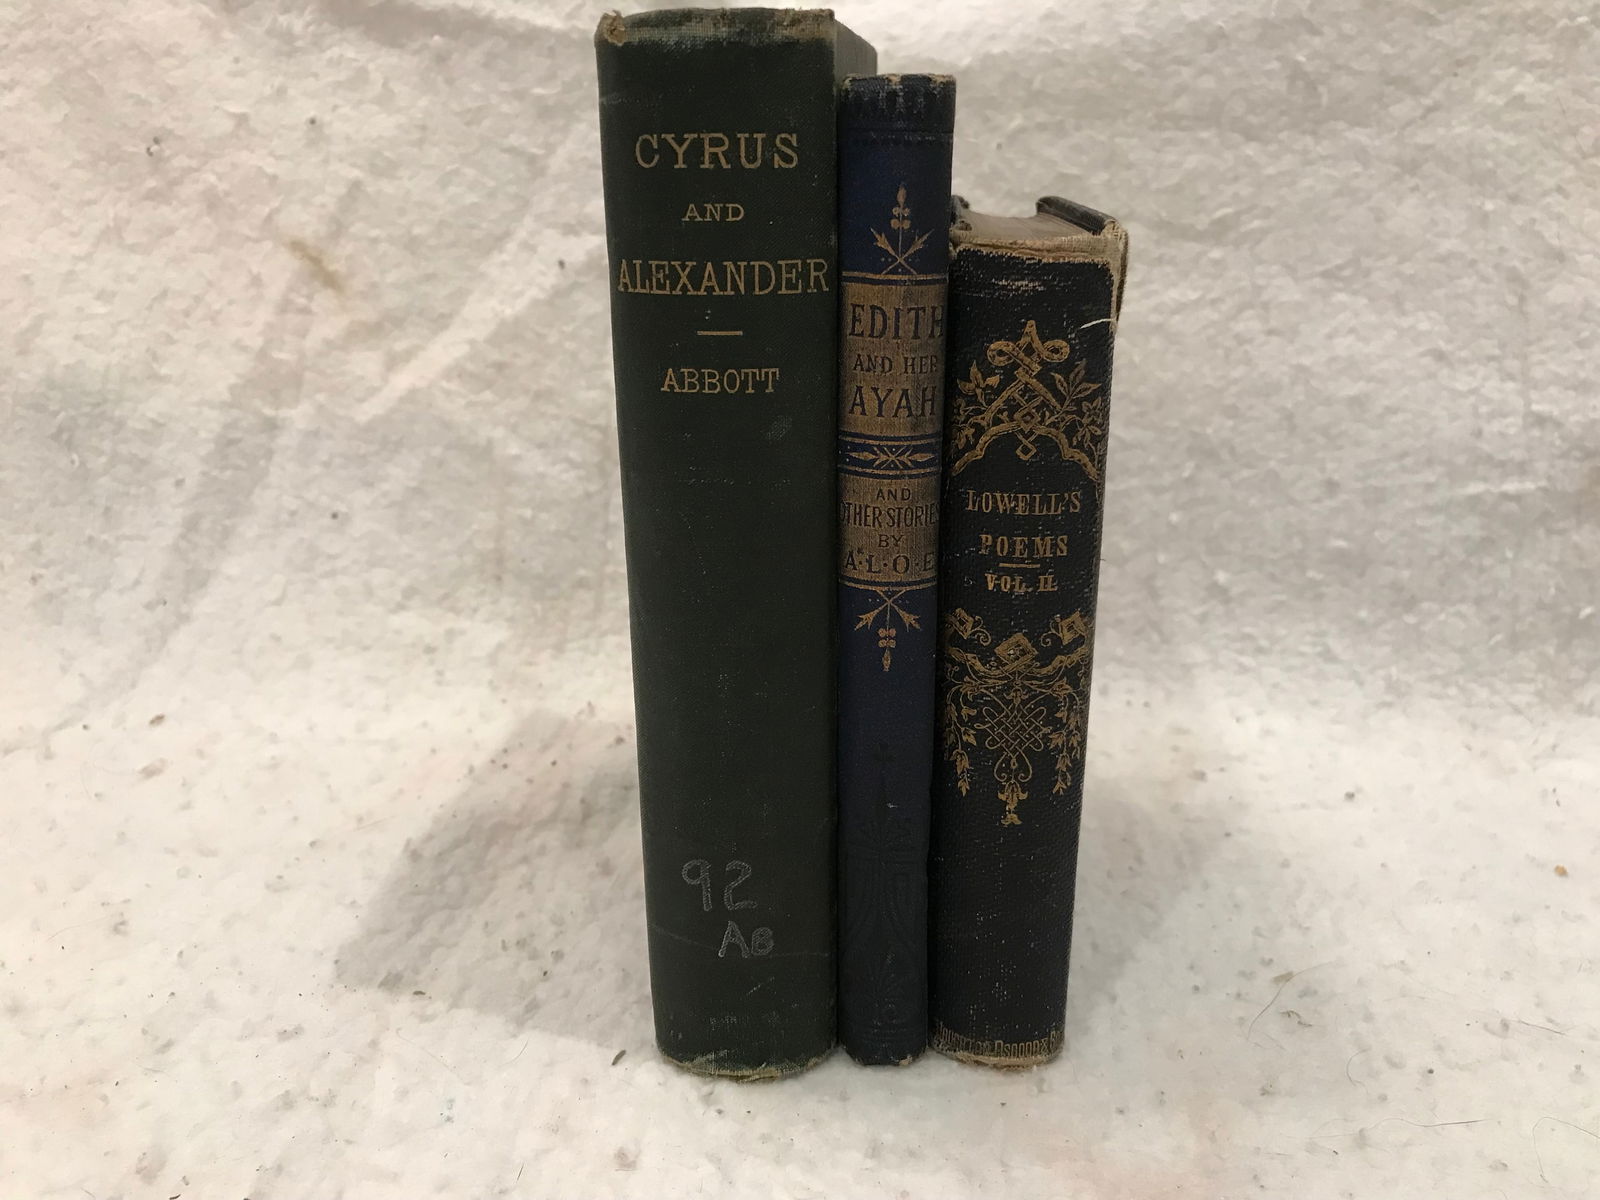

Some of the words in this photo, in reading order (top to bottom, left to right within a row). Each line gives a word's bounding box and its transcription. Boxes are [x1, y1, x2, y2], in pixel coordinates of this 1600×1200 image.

[635, 132, 799, 169] CYRUS
[681, 203, 745, 222] AND
[617, 257, 829, 296] ALEXANDER
[849, 302, 944, 340] EDITH
[853, 353, 893, 375] AND
[904, 354, 939, 375] HER
[660, 367, 779, 394] ABBOTT
[849, 384, 937, 418] AYAH
[876, 487, 911, 501] AND
[965, 489, 1081, 516] LOWELL'S
[878, 533, 905, 548] BY
[978, 533, 1069, 558] POEMS
[682, 859, 757, 911] 92
